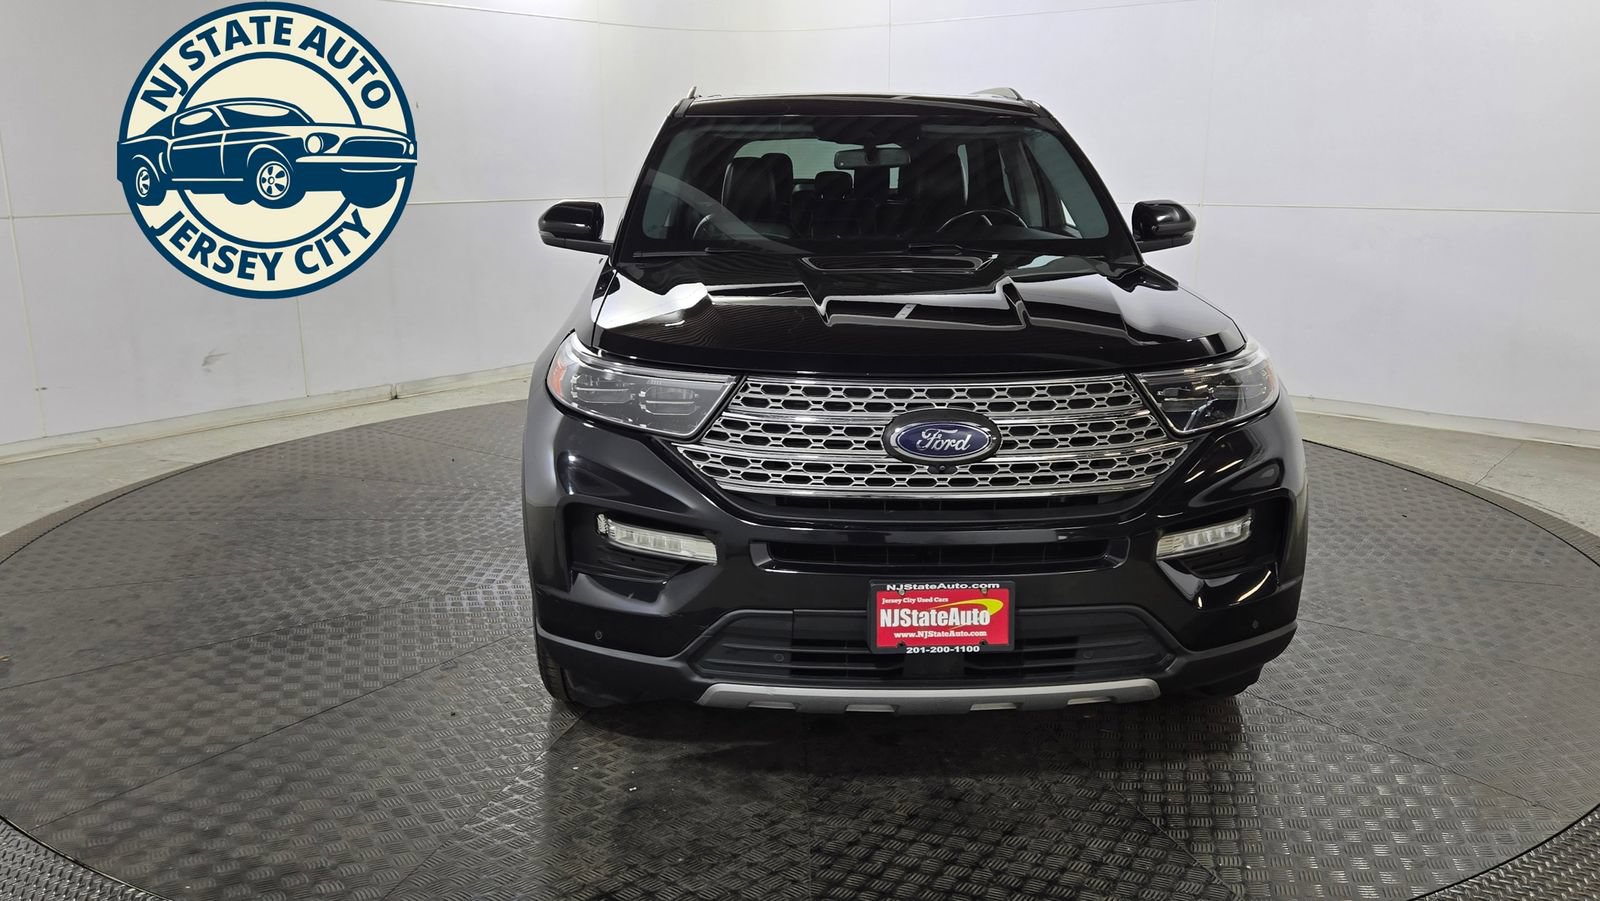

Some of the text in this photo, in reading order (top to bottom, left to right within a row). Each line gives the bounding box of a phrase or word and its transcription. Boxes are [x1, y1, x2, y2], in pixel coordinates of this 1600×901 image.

[916, 429, 972, 450] Ford
[886, 583, 1000, 591] NJStateAuto.com
[882, 597, 902, 605] Jersey
[880, 607, 991, 628] NJStateAuto
[893, 630, 987, 639] www.NJStateAuto.com
[906, 645, 980, 654] 201-200-1100
